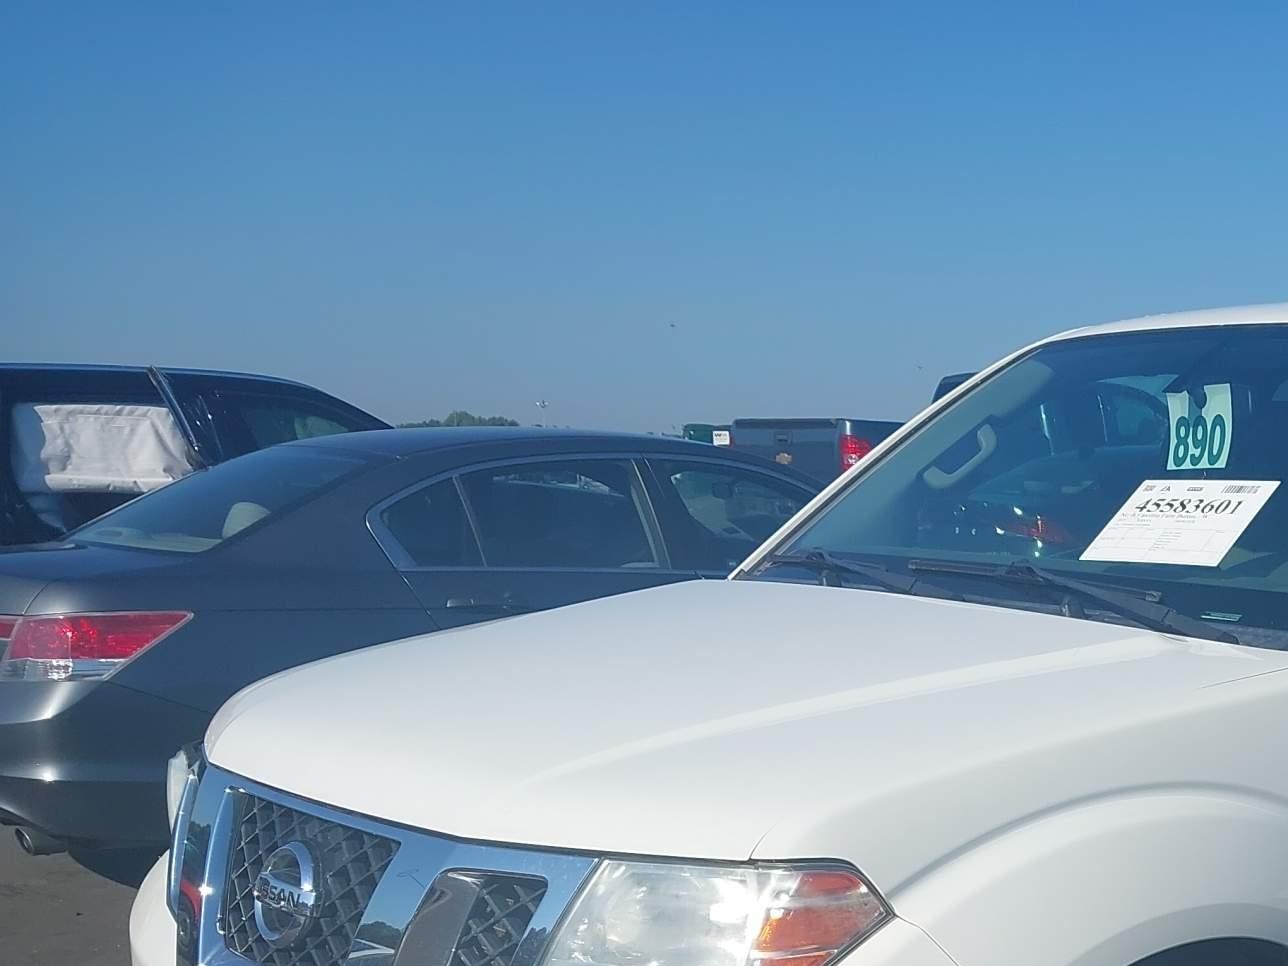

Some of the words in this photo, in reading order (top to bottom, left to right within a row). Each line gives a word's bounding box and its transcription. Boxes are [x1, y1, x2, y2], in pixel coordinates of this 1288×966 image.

[1172, 413, 1227, 468] 890
[1135, 498, 1246, 515] 45583601
[257, 877, 301, 908] SSAN
